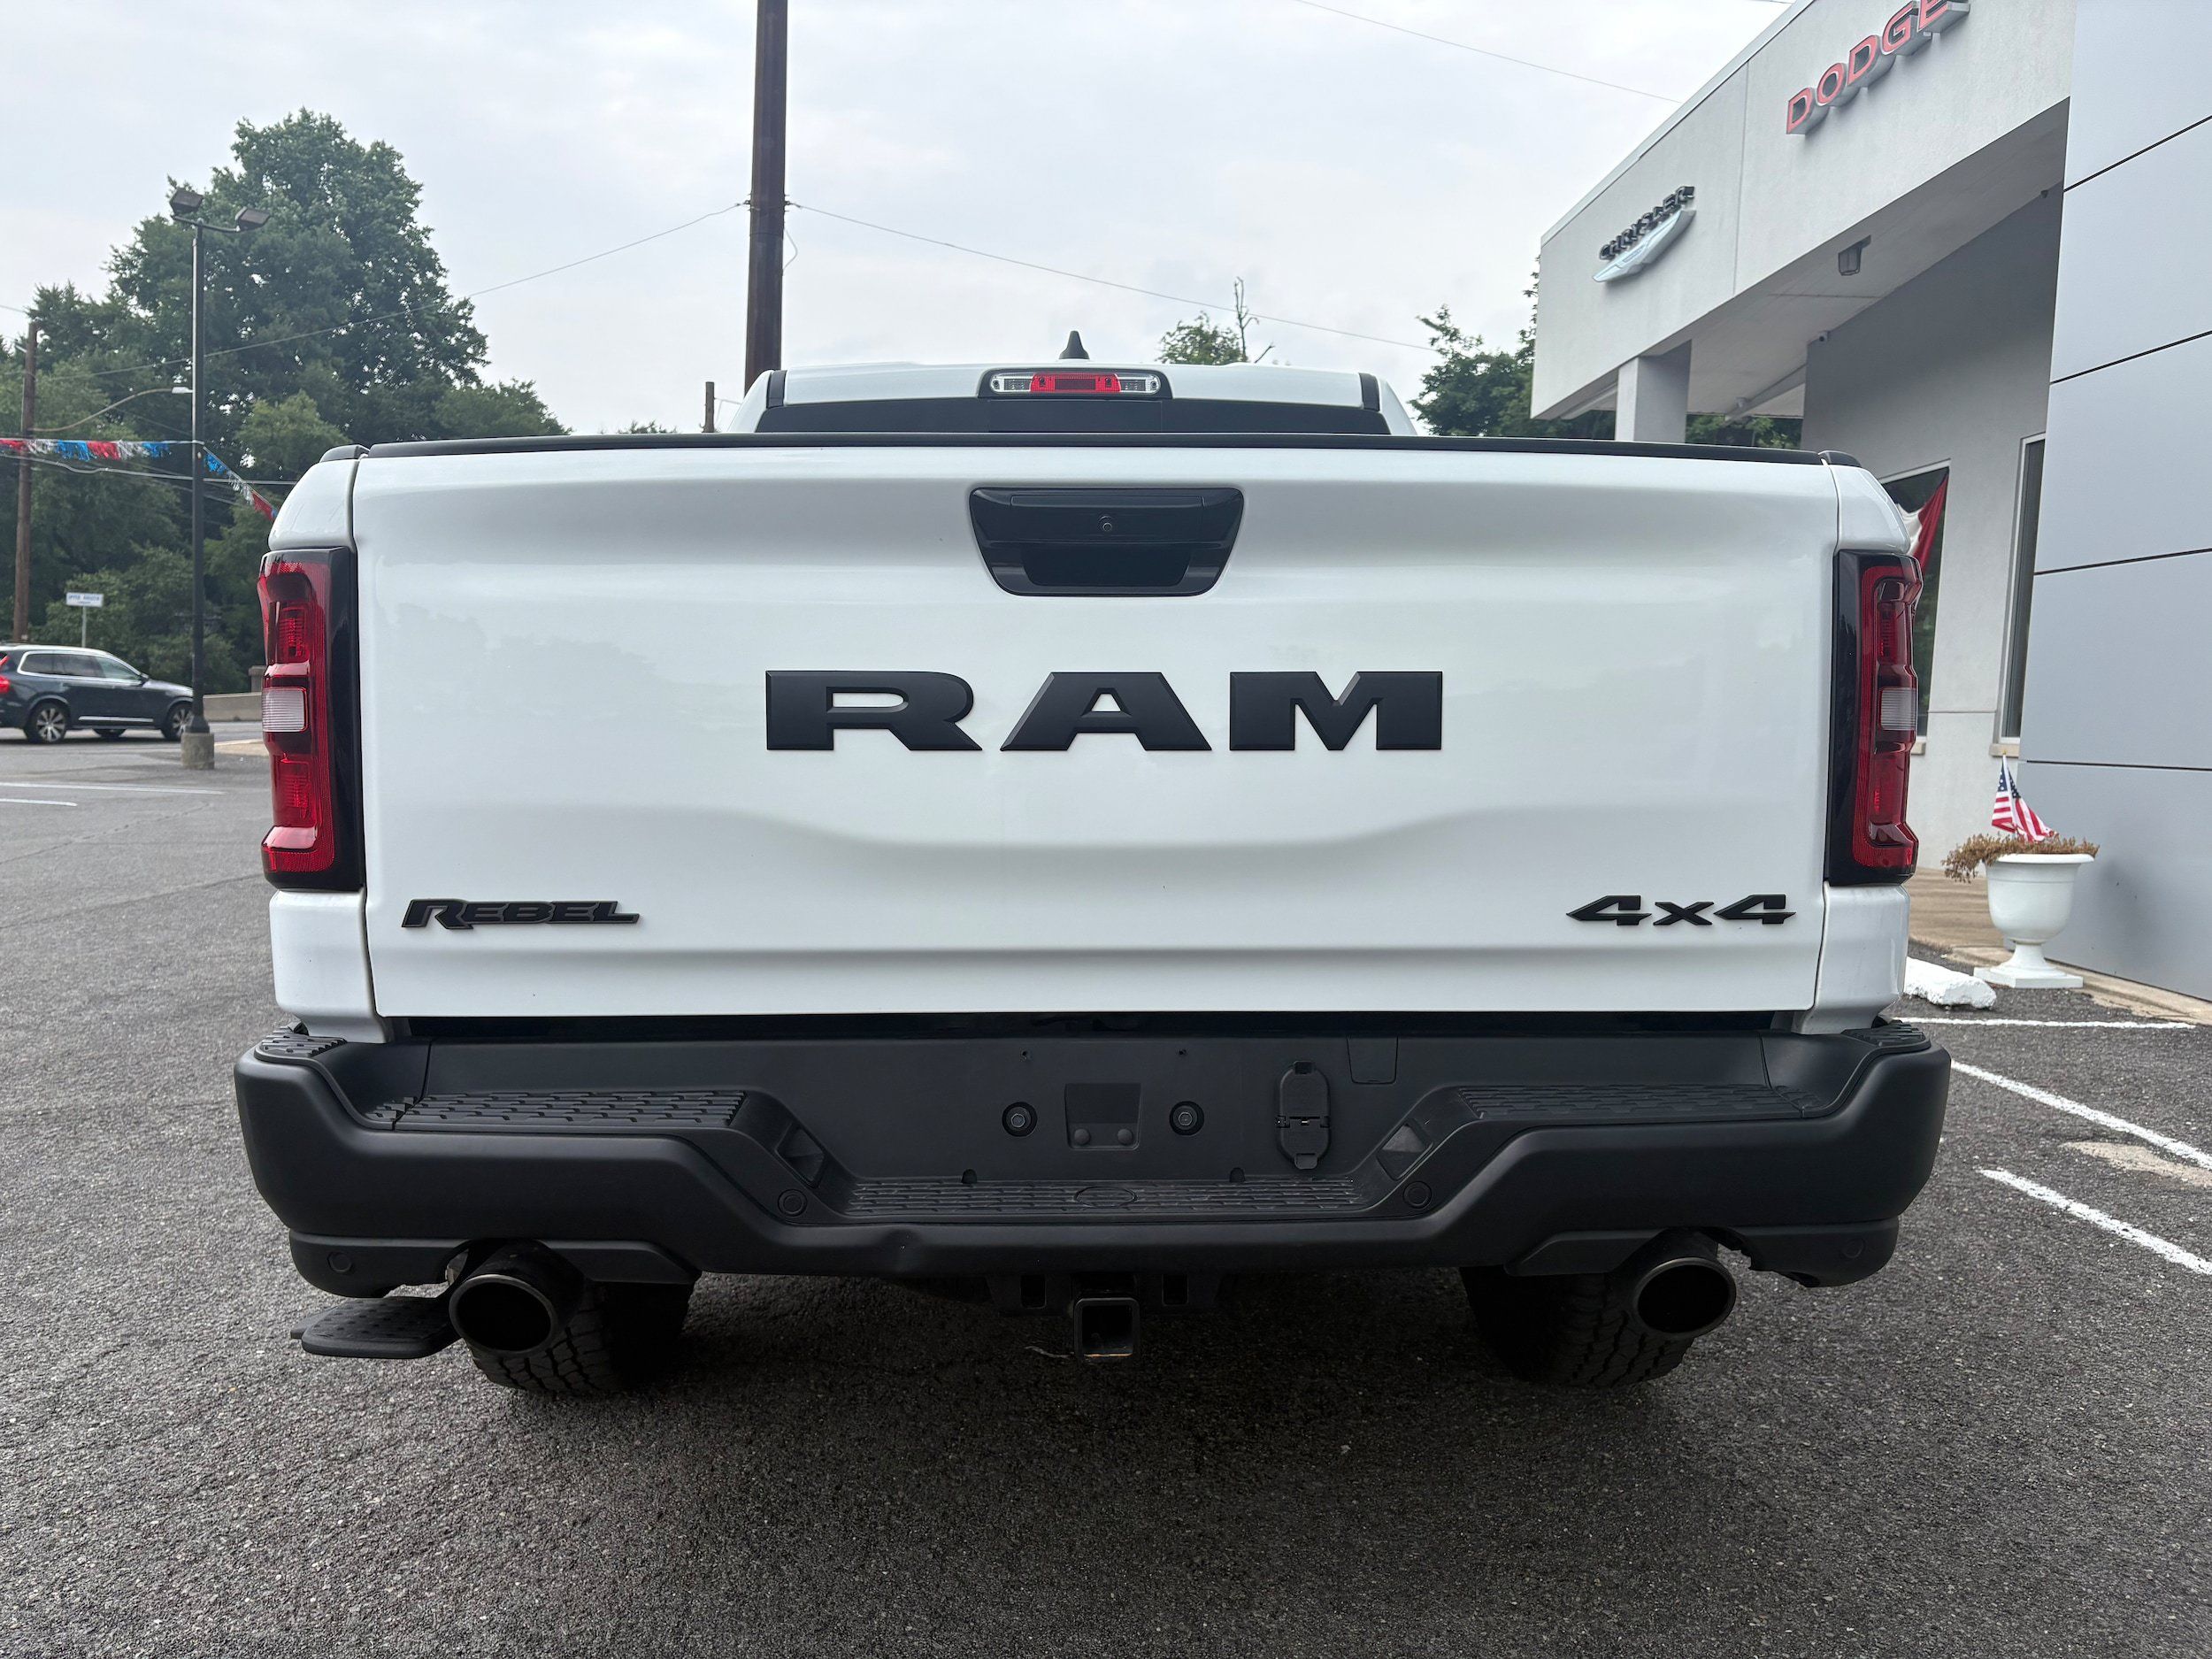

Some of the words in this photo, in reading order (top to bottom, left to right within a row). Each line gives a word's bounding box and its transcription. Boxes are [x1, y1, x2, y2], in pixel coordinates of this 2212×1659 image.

[1786, 0, 1950, 134] DODGE
[765, 670, 1443, 751] RAM
[401, 898, 641, 930] REBEL
[1565, 894, 1798, 926] 4x4
